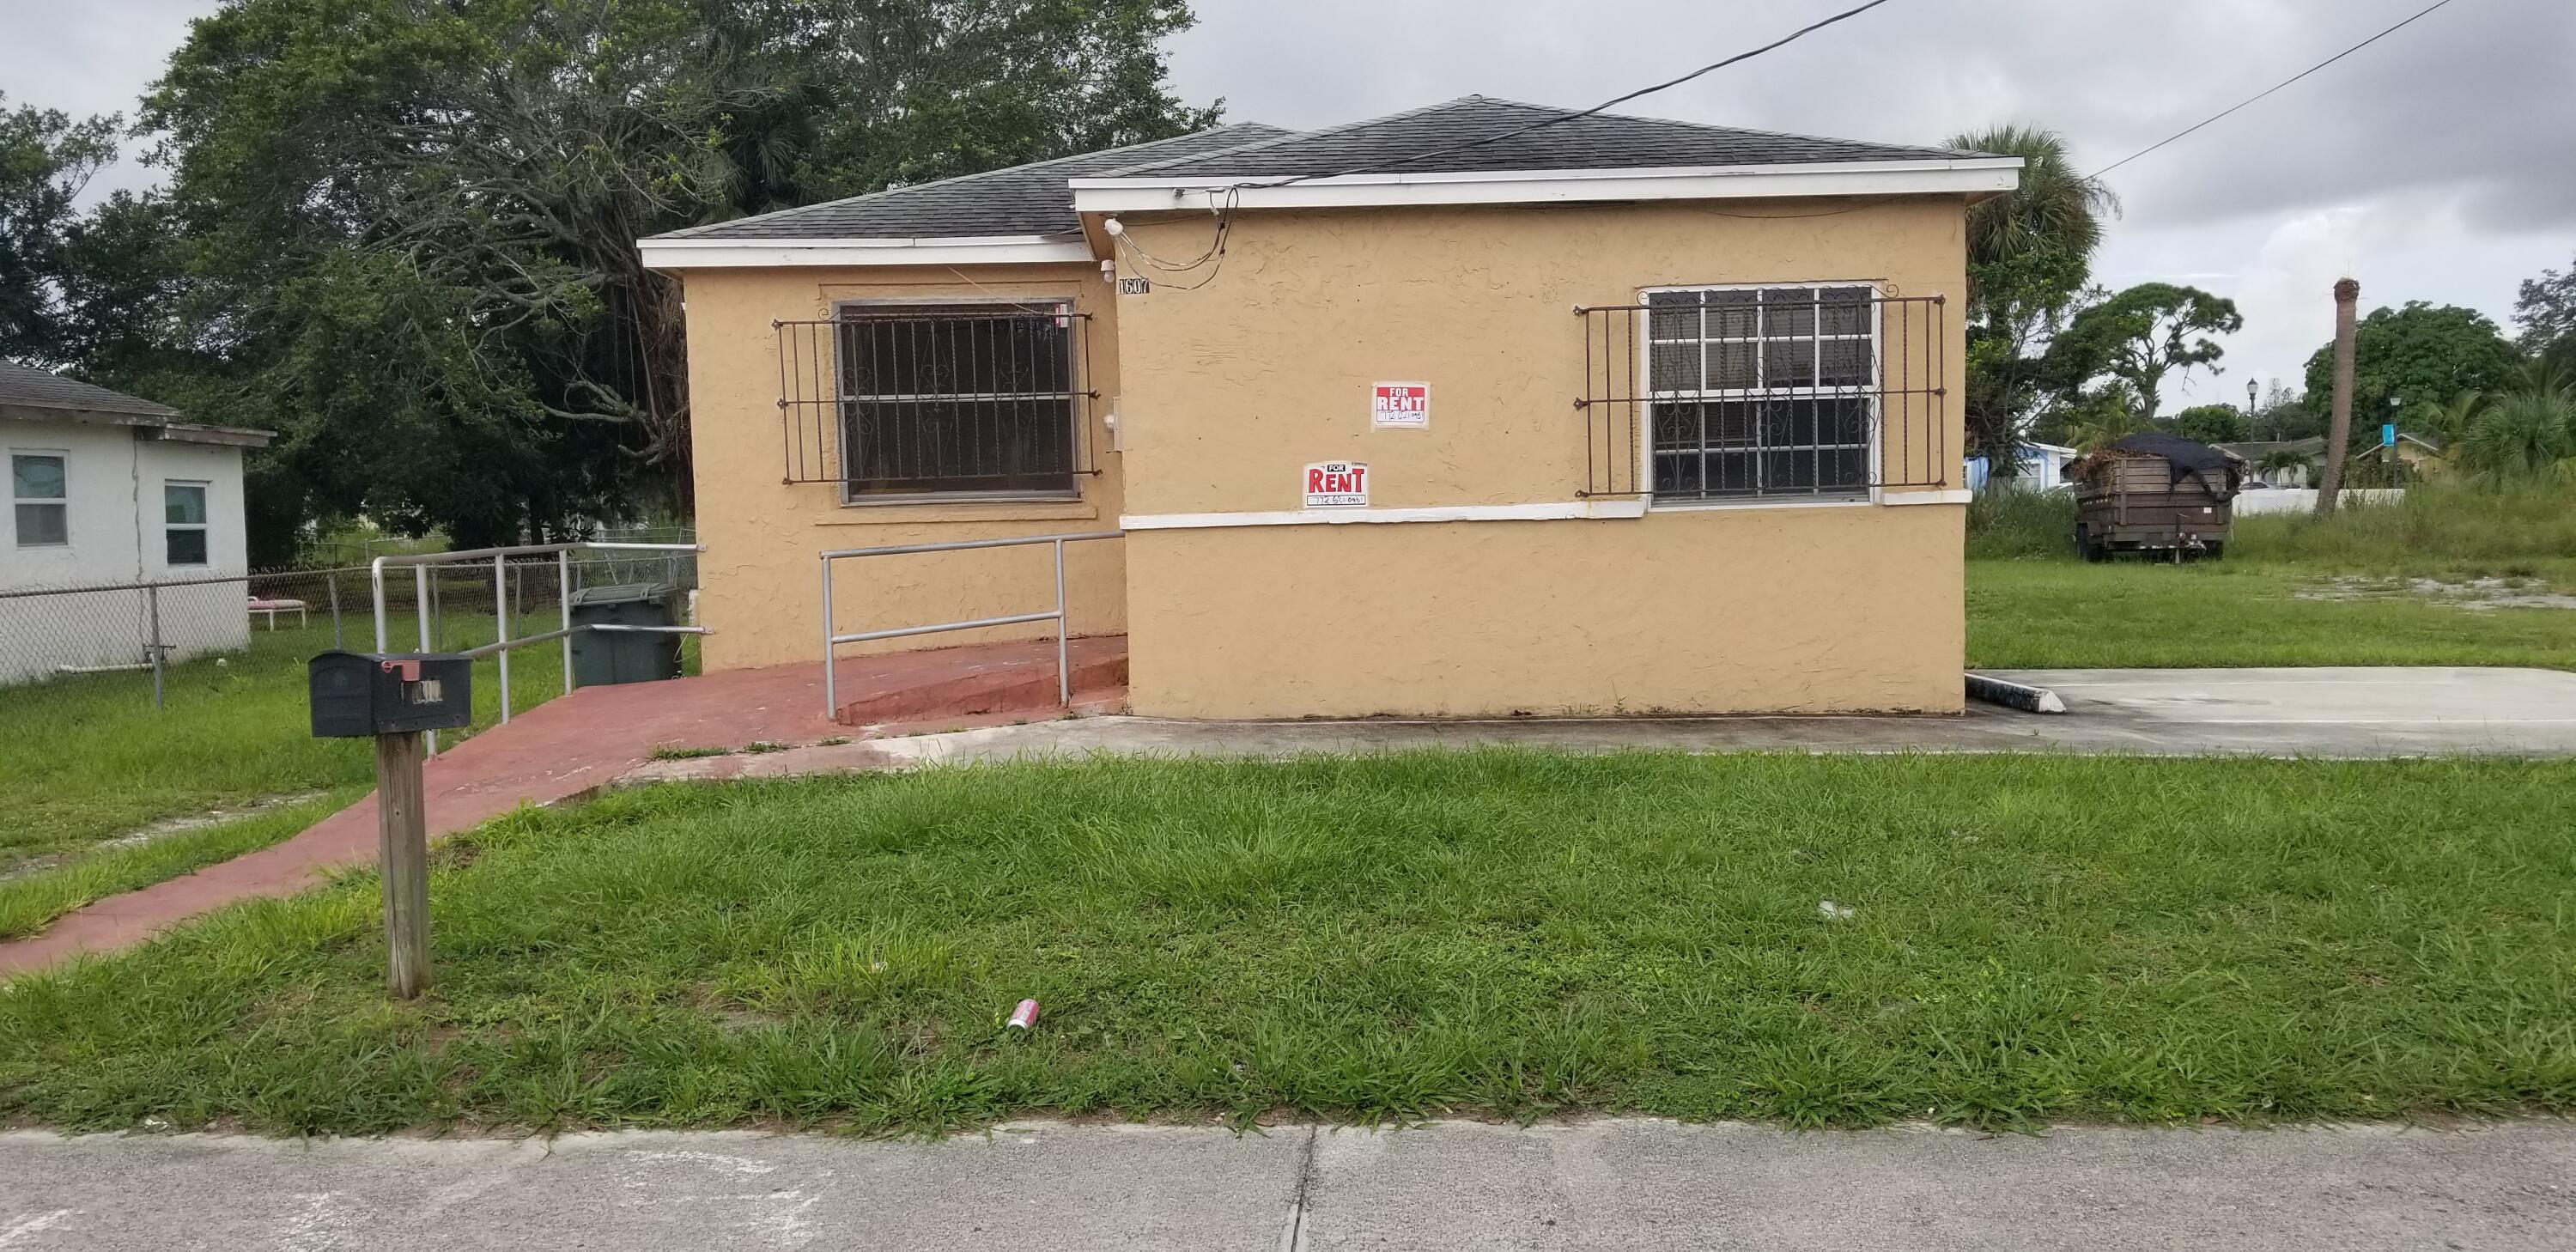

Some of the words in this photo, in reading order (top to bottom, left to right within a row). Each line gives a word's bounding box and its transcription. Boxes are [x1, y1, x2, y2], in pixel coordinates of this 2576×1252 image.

[1119, 278, 1149, 295] 1607
[1389, 387, 1408, 397] FOR
[1377, 396, 1424, 410] RENT
[1309, 468, 1364, 493] RENT
